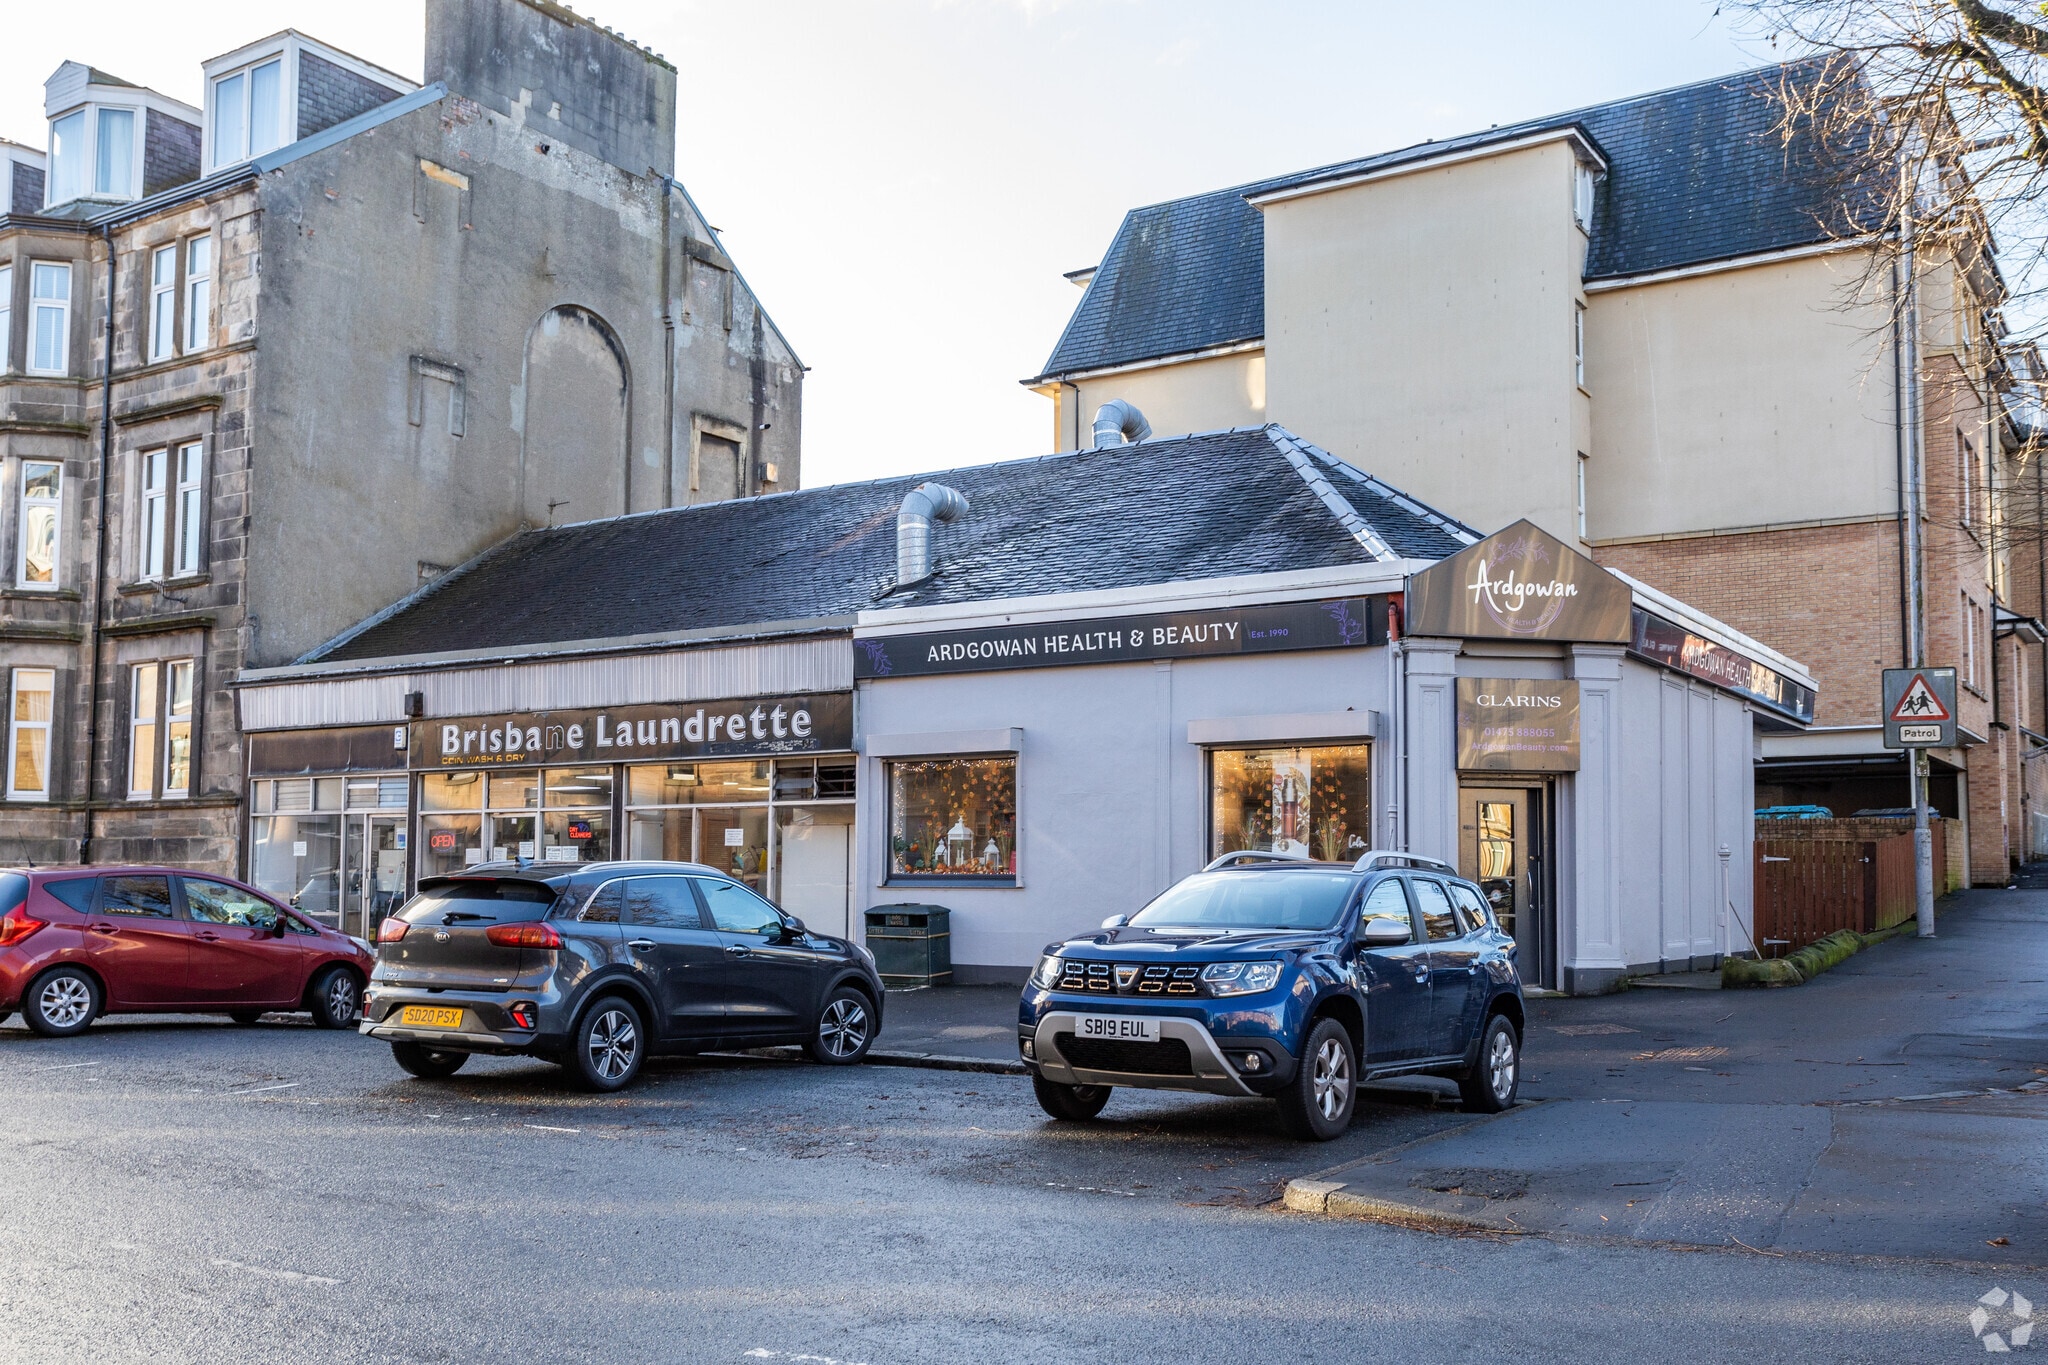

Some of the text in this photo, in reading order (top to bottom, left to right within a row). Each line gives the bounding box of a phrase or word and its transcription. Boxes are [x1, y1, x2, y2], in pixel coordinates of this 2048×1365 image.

[1467, 558, 1578, 613] Ardgowan
[1506, 616, 1533, 626] HEALTH
[1536, 603, 1556, 623] BEAUTY
[927, 621, 1289, 662] ARDGOWAN HEALTH & BEAUTY Est. 1990
[1725, 660, 1752, 688] HEALTH
[1476, 693, 1562, 708] CLARINS
[440, 720, 584, 756] Brisbane
[596, 703, 812, 748] Laundrette
[1484, 727, 1555, 737] 01475 888055
[1904, 729, 1937, 738] Patrol
[1472, 742, 1568, 753] ArdgowanBeauty.com
[467, 754, 494, 764] WASH
[495, 754, 503, 762] &
[505, 753, 526, 762] DRY
[430, 834, 455, 848] OPEN
[408, 1008, 458, 1024] SD20 PSX
[1085, 1018, 1150, 1038] SB19 EUL
